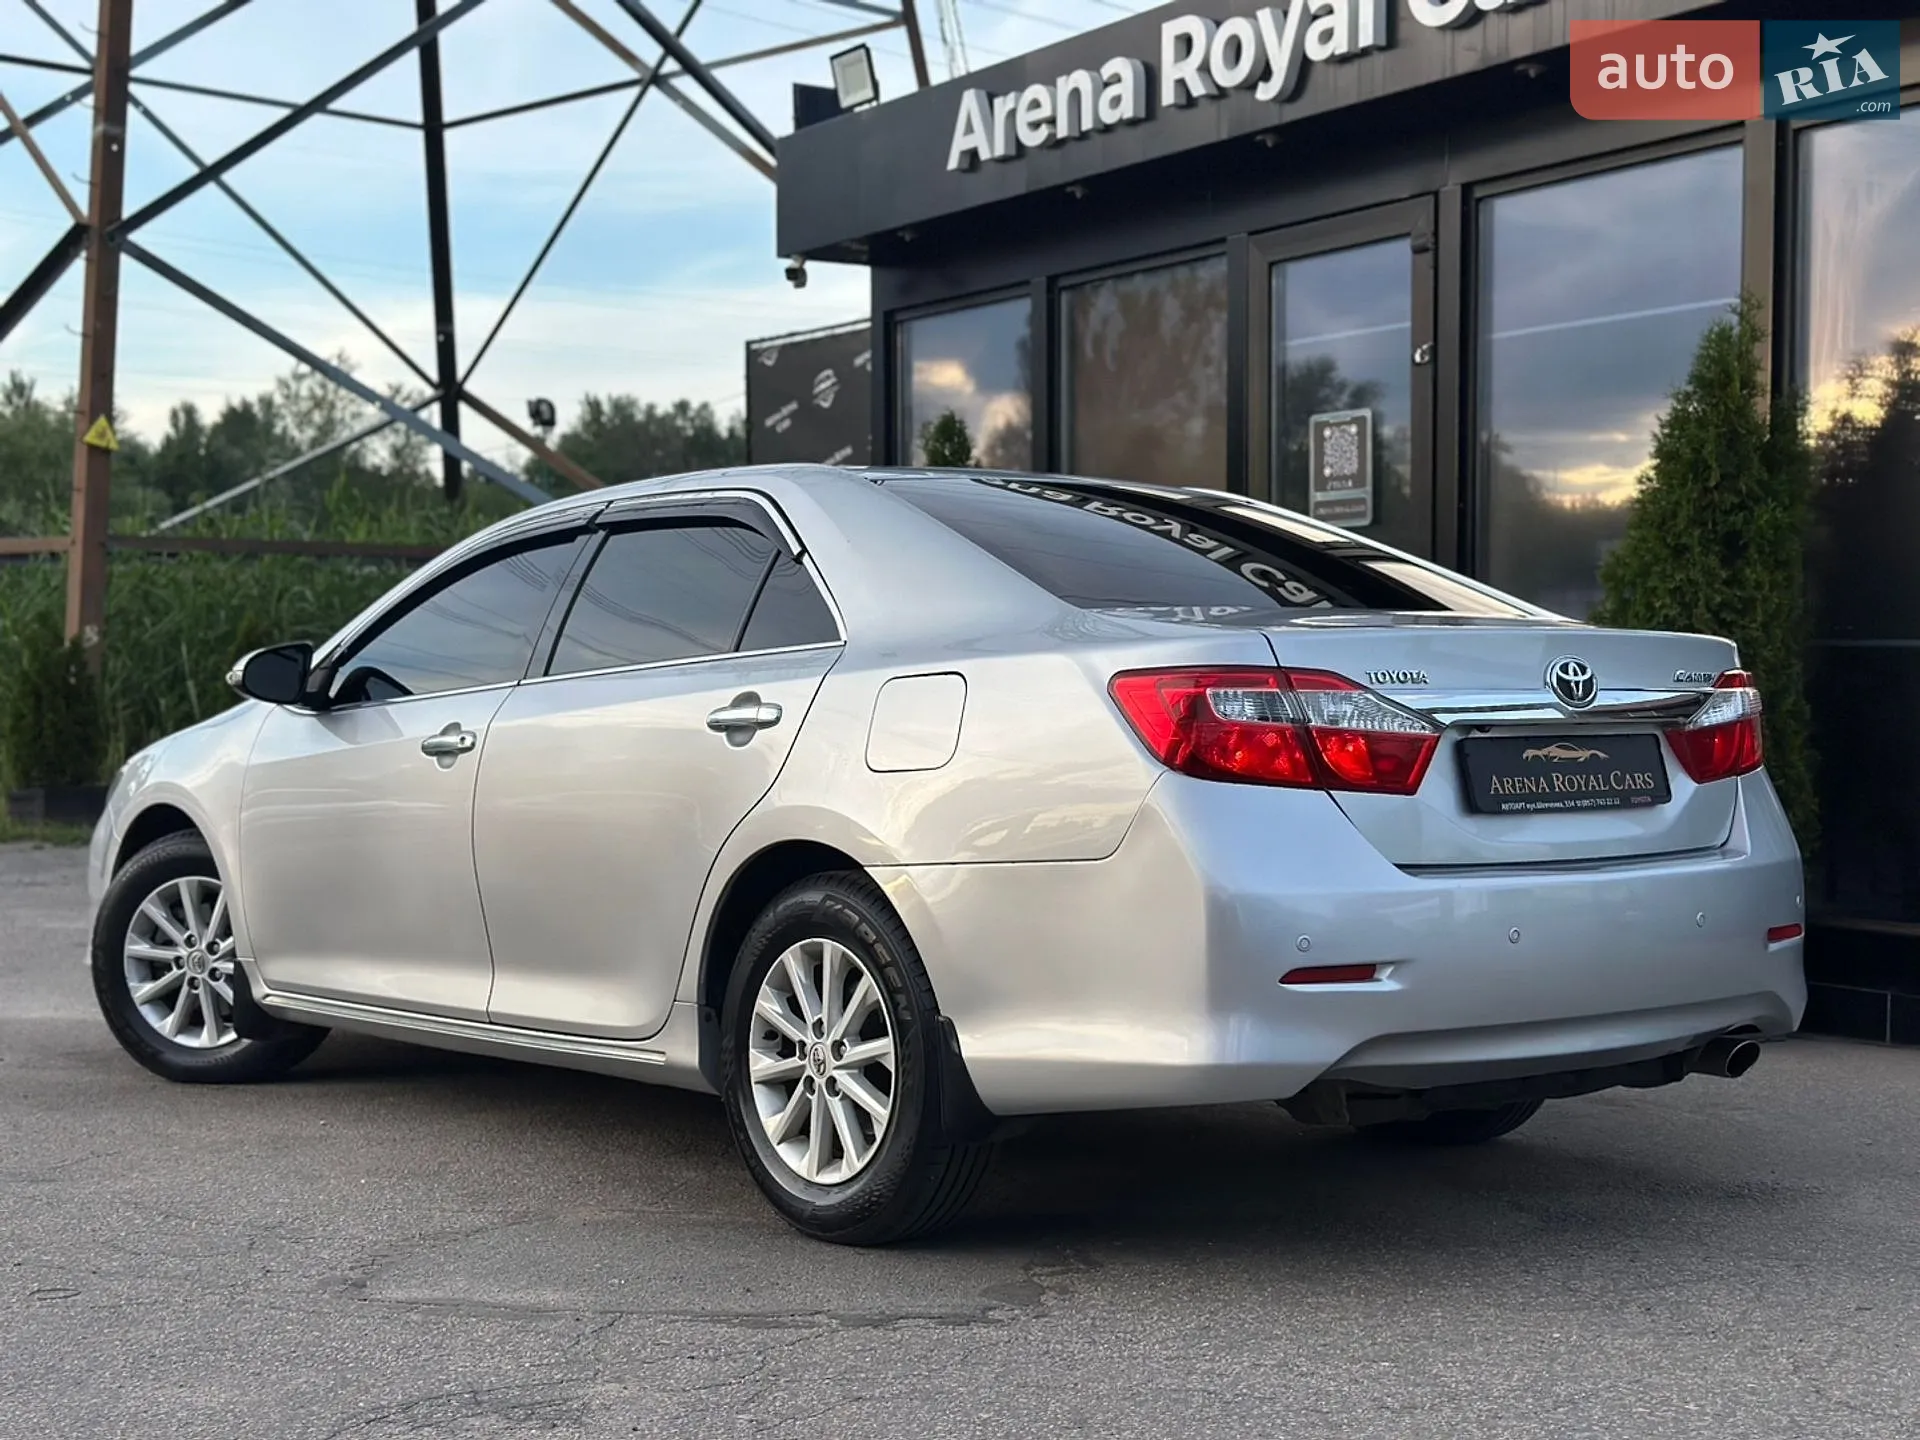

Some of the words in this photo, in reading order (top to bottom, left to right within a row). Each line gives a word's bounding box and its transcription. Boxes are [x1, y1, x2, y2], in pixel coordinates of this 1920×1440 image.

[946, 56, 1142, 171] Arena
[1161, 0, 1382, 107] Royal
[1366, 669, 1429, 685] TOYOTA
[1490, 775, 1550, 795] ARENA
[1552, 772, 1609, 792] ROYAL
[1610, 770, 1654, 790] CARS
